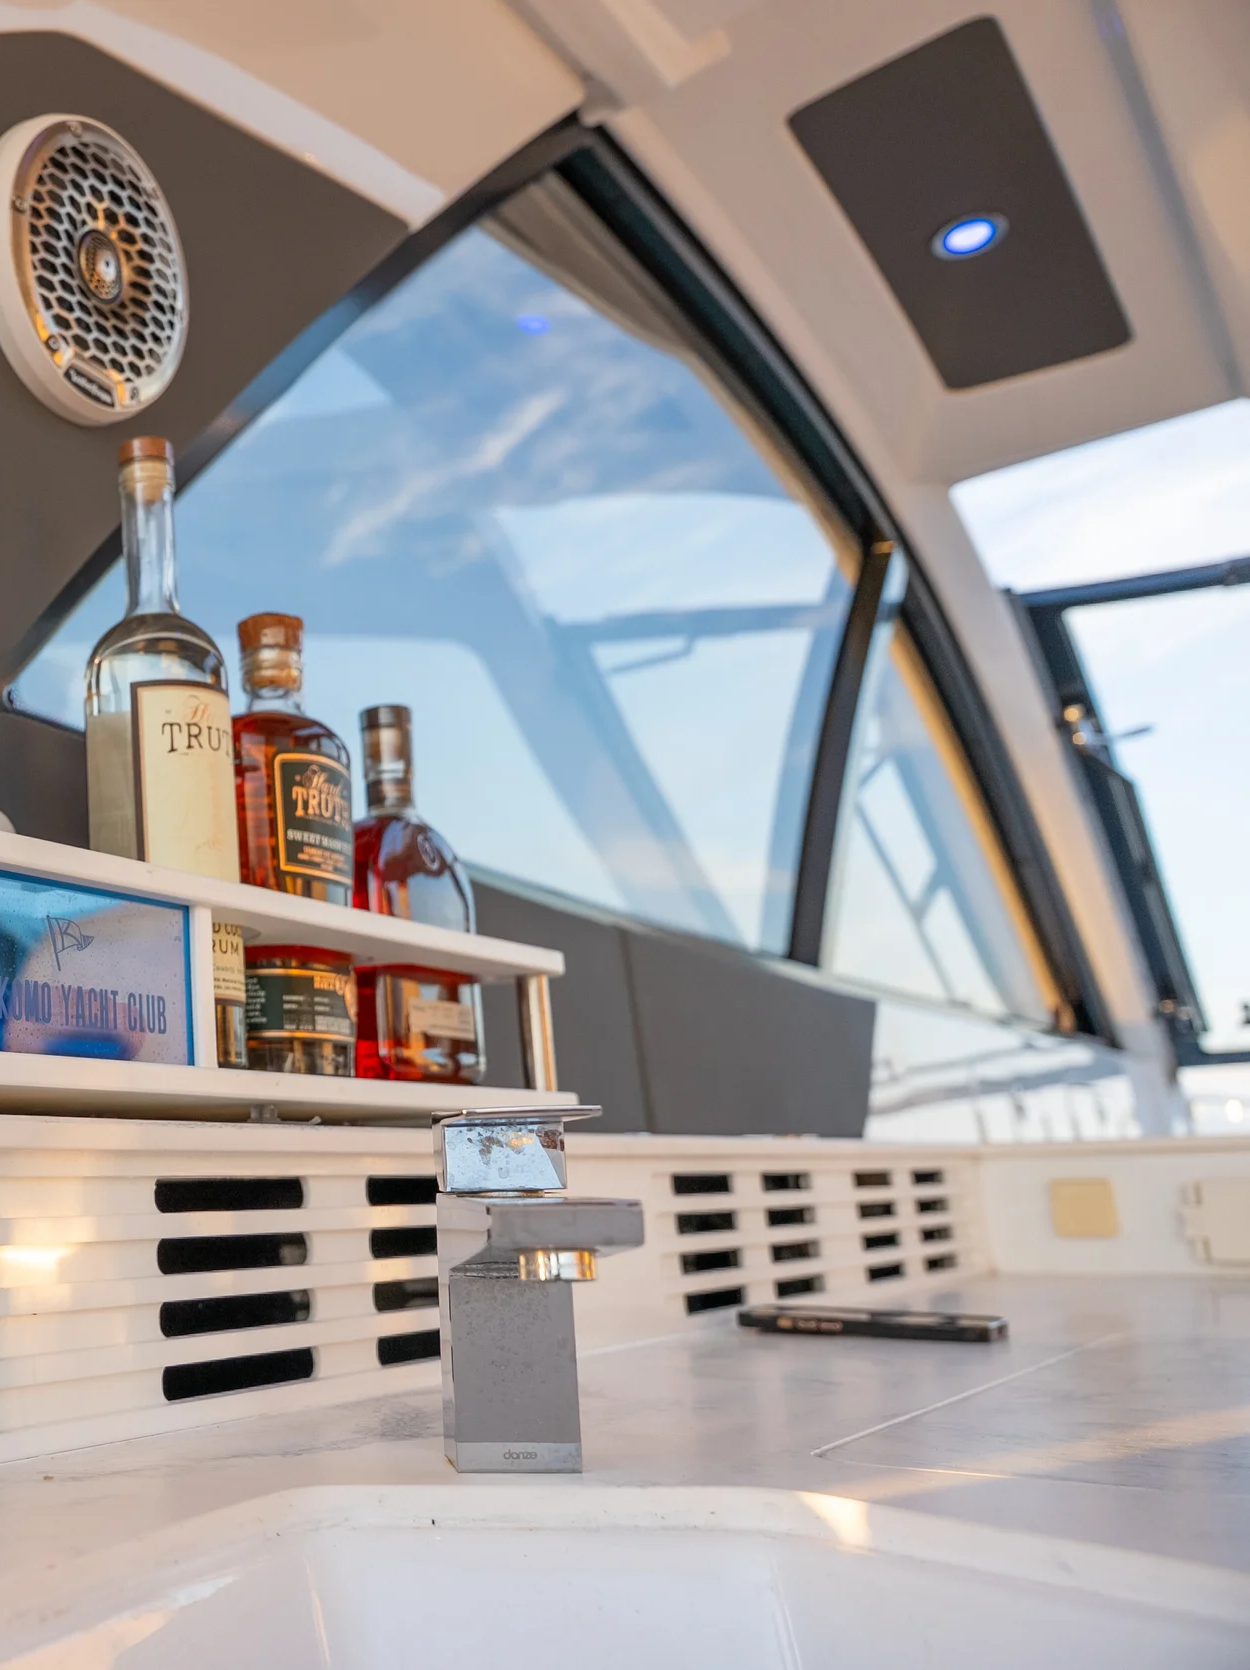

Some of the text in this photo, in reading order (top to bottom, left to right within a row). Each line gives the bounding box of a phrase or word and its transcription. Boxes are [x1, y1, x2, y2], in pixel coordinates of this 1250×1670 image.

[61, 983, 119, 1030] YACHT
[127, 992, 168, 1035] CLUB
[503, 1448, 538, 1460] danze
